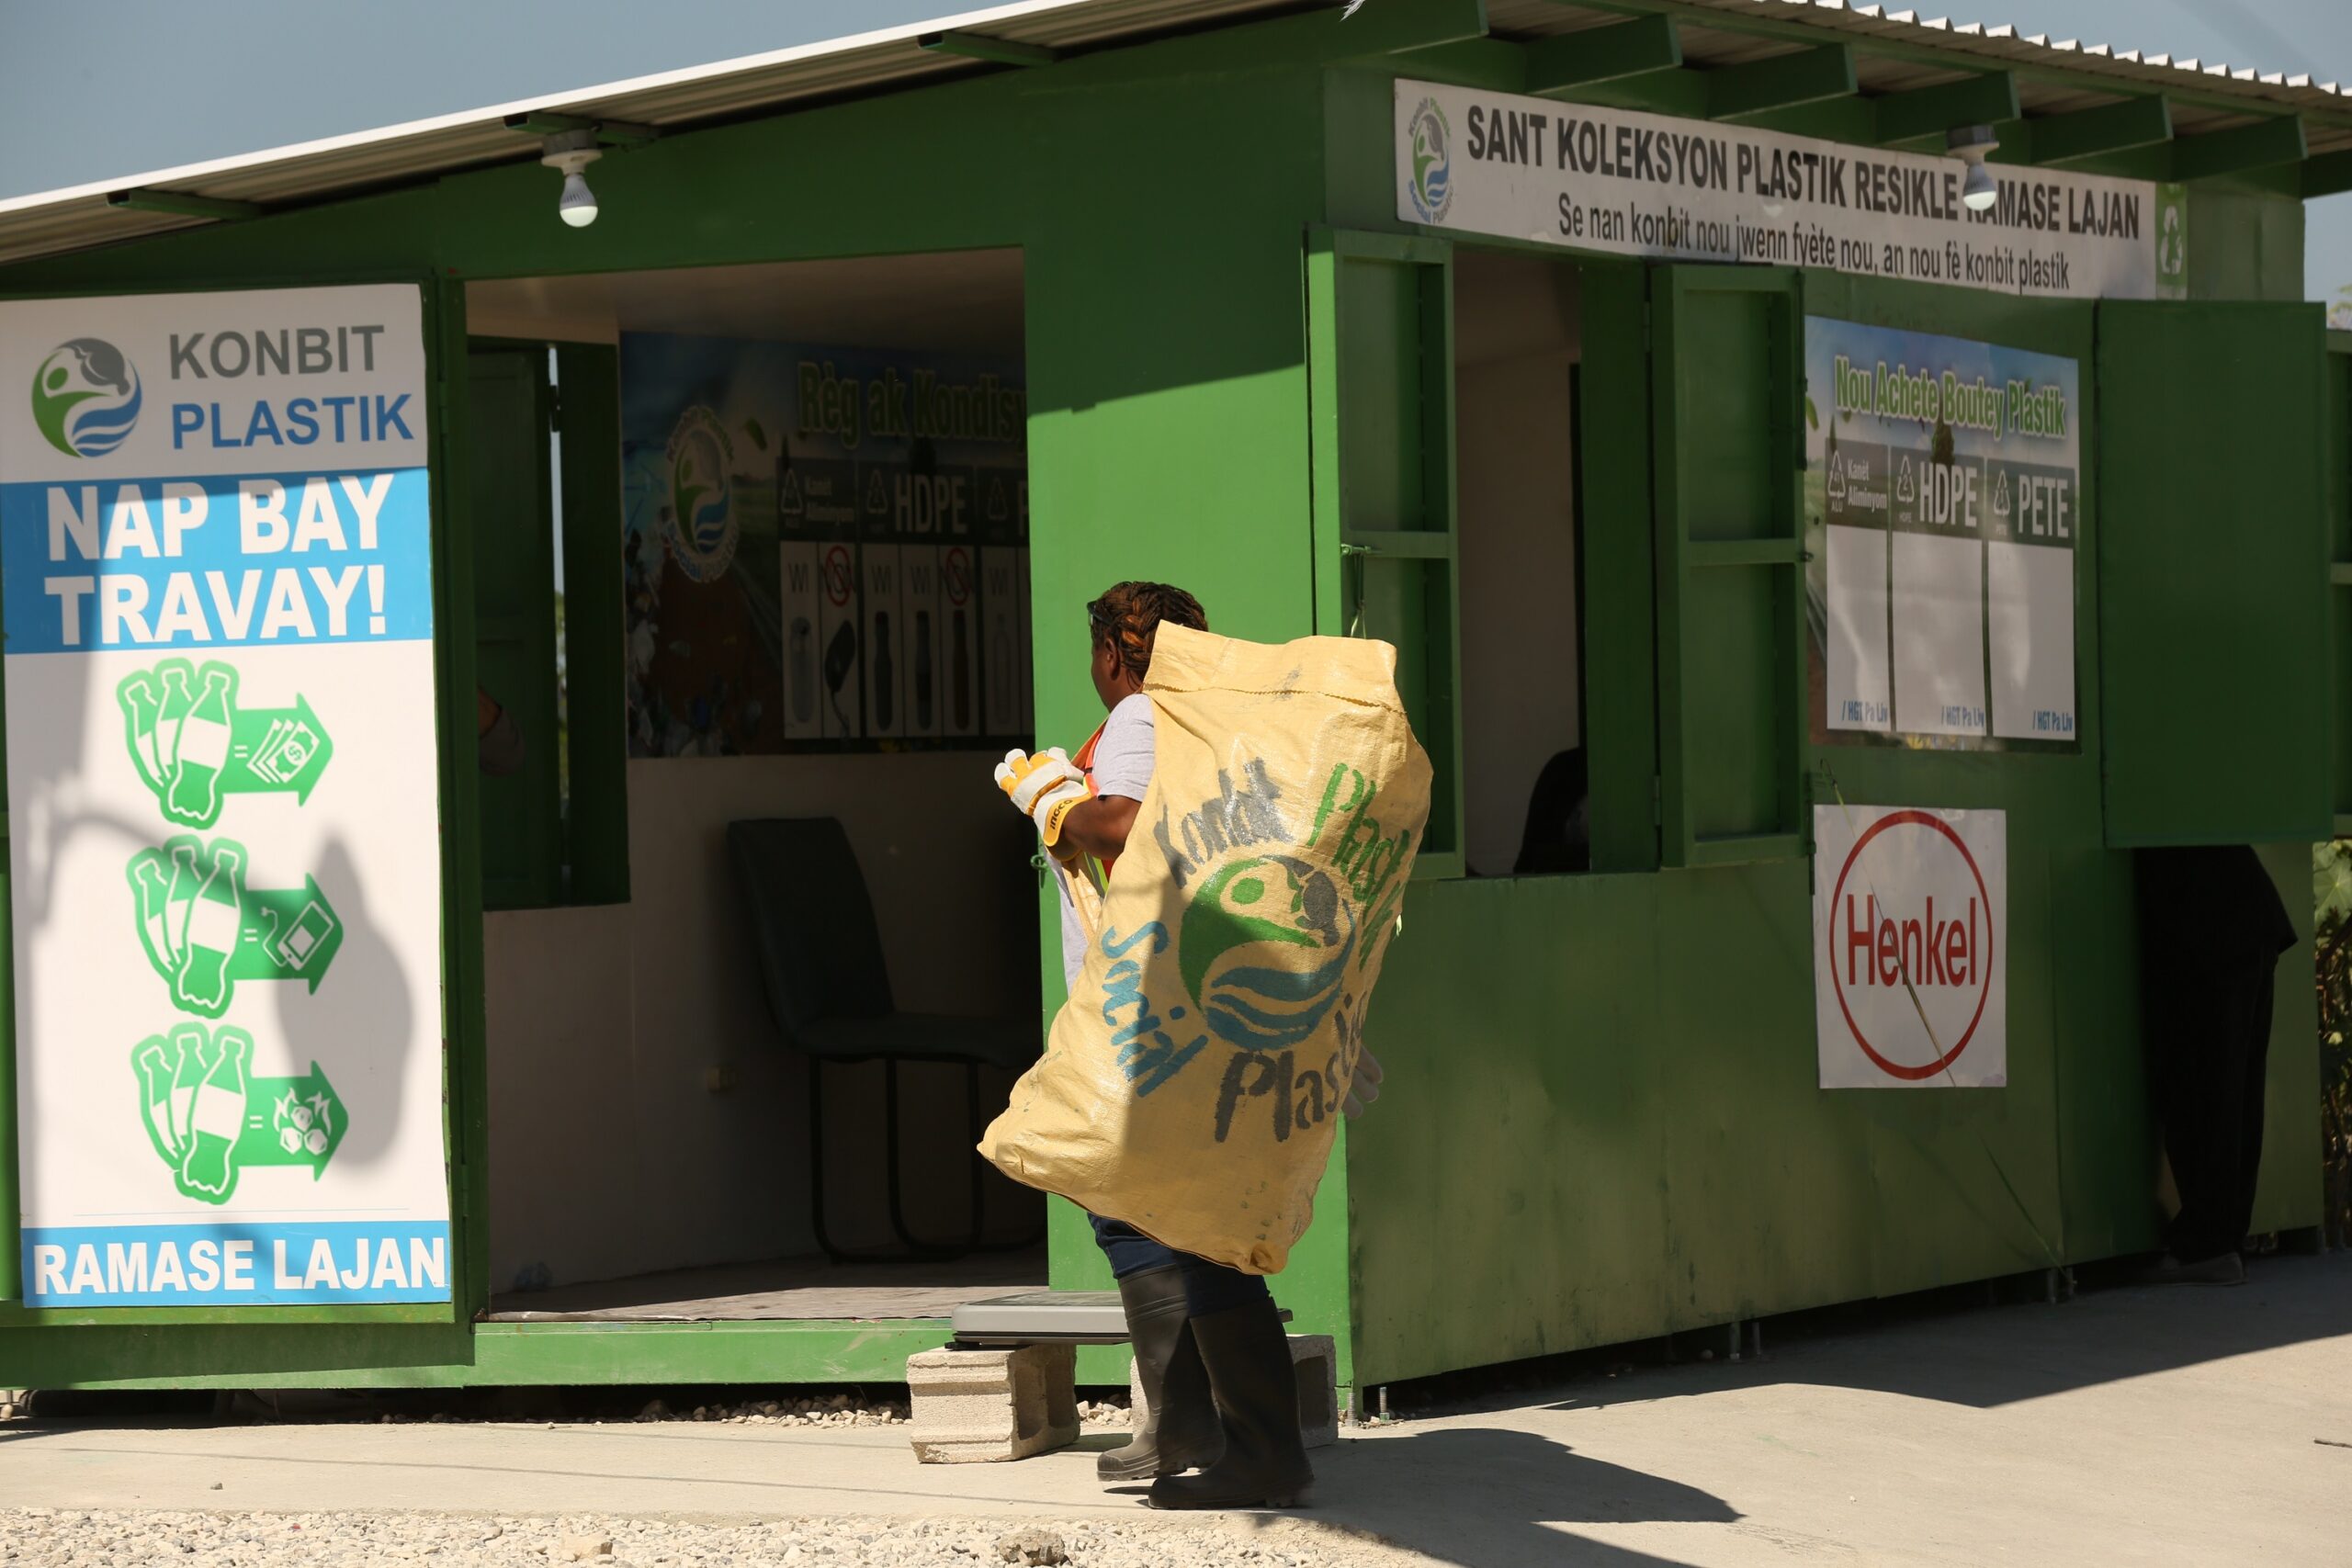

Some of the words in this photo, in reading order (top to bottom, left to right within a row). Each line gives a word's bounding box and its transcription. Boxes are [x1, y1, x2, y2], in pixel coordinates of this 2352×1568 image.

[1467, 105, 1546, 167] SANT
[1557, 118, 1727, 192] KOLEKSYON
[1738, 143, 1847, 209] PLASTIK
[1855, 161, 1959, 221] RESIKLE
[1966, 179, 2061, 232] MASE
[2068, 187, 2140, 240] LAJAN
[1559, 192, 1583, 237] Se
[1589, 207, 1624, 242] nan
[1631, 201, 1691, 250] konbit
[1696, 220, 1730, 254] nou
[1736, 214, 1788, 262] jwenn
[1793, 221, 1836, 266] fyète
[1840, 237, 1878, 275] nou,
[1883, 243, 1905, 274] an
[1910, 245, 1940, 278] nou
[1945, 241, 1961, 280] fè
[1966, 243, 2015, 286] konbit
[2019, 249, 2070, 294] plastik
[169, 325, 385, 379] KONBIT
[172, 393, 415, 449] PLASTIK
[797, 360, 860, 449] Règ
[868, 367, 909, 436] ak
[1835, 355, 1871, 412] Nou
[1875, 361, 1939, 422] Achete
[1942, 371, 2004, 440] Boutey
[2007, 379, 2066, 438] Plastik
[47, 481, 209, 561] NAP
[238, 473, 395, 555] BAY
[895, 472, 968, 534] HDPE
[1919, 461, 1978, 528] HDPE
[2018, 475, 2069, 538] PETE
[44, 564, 387, 646] TRAVAY!
[788, 563, 809, 593] WI
[872, 564, 891, 594] WI
[910, 565, 929, 594] WI
[2037, 711, 2051, 730] HGT
[1847, 894, 1976, 987] Henkel
[34, 1239, 255, 1296] RAMASE
[273, 1237, 446, 1291] LAJAN
